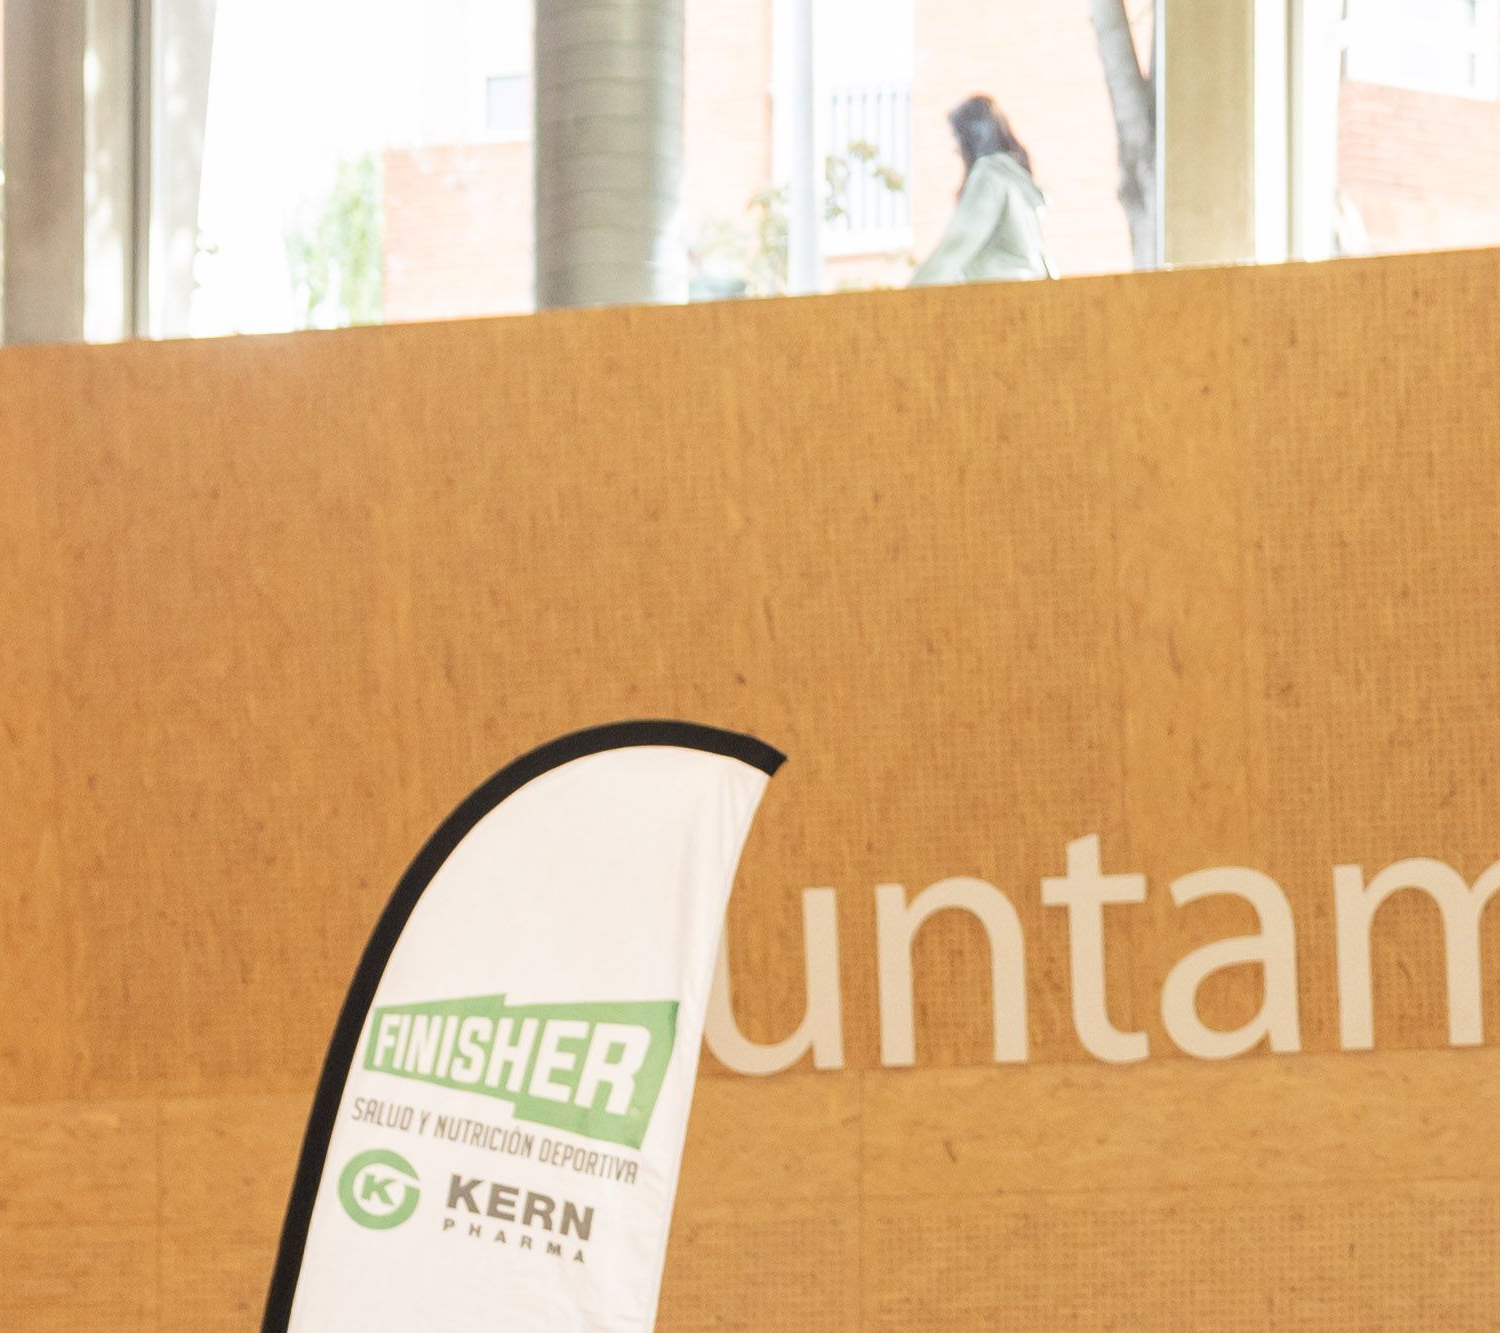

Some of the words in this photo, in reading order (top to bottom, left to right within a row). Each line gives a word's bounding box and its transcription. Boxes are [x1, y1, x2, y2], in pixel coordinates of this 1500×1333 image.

[371, 1012, 652, 1117] FINISHER
[351, 1096, 410, 1132] SALUD
[418, 1110, 433, 1134] Y
[434, 1116, 533, 1161] NUTRICIÓN
[538, 1136, 639, 1186] DEPORTIVA
[442, 1218, 586, 1265] PHARMA
[445, 1173, 595, 1242] KERN
